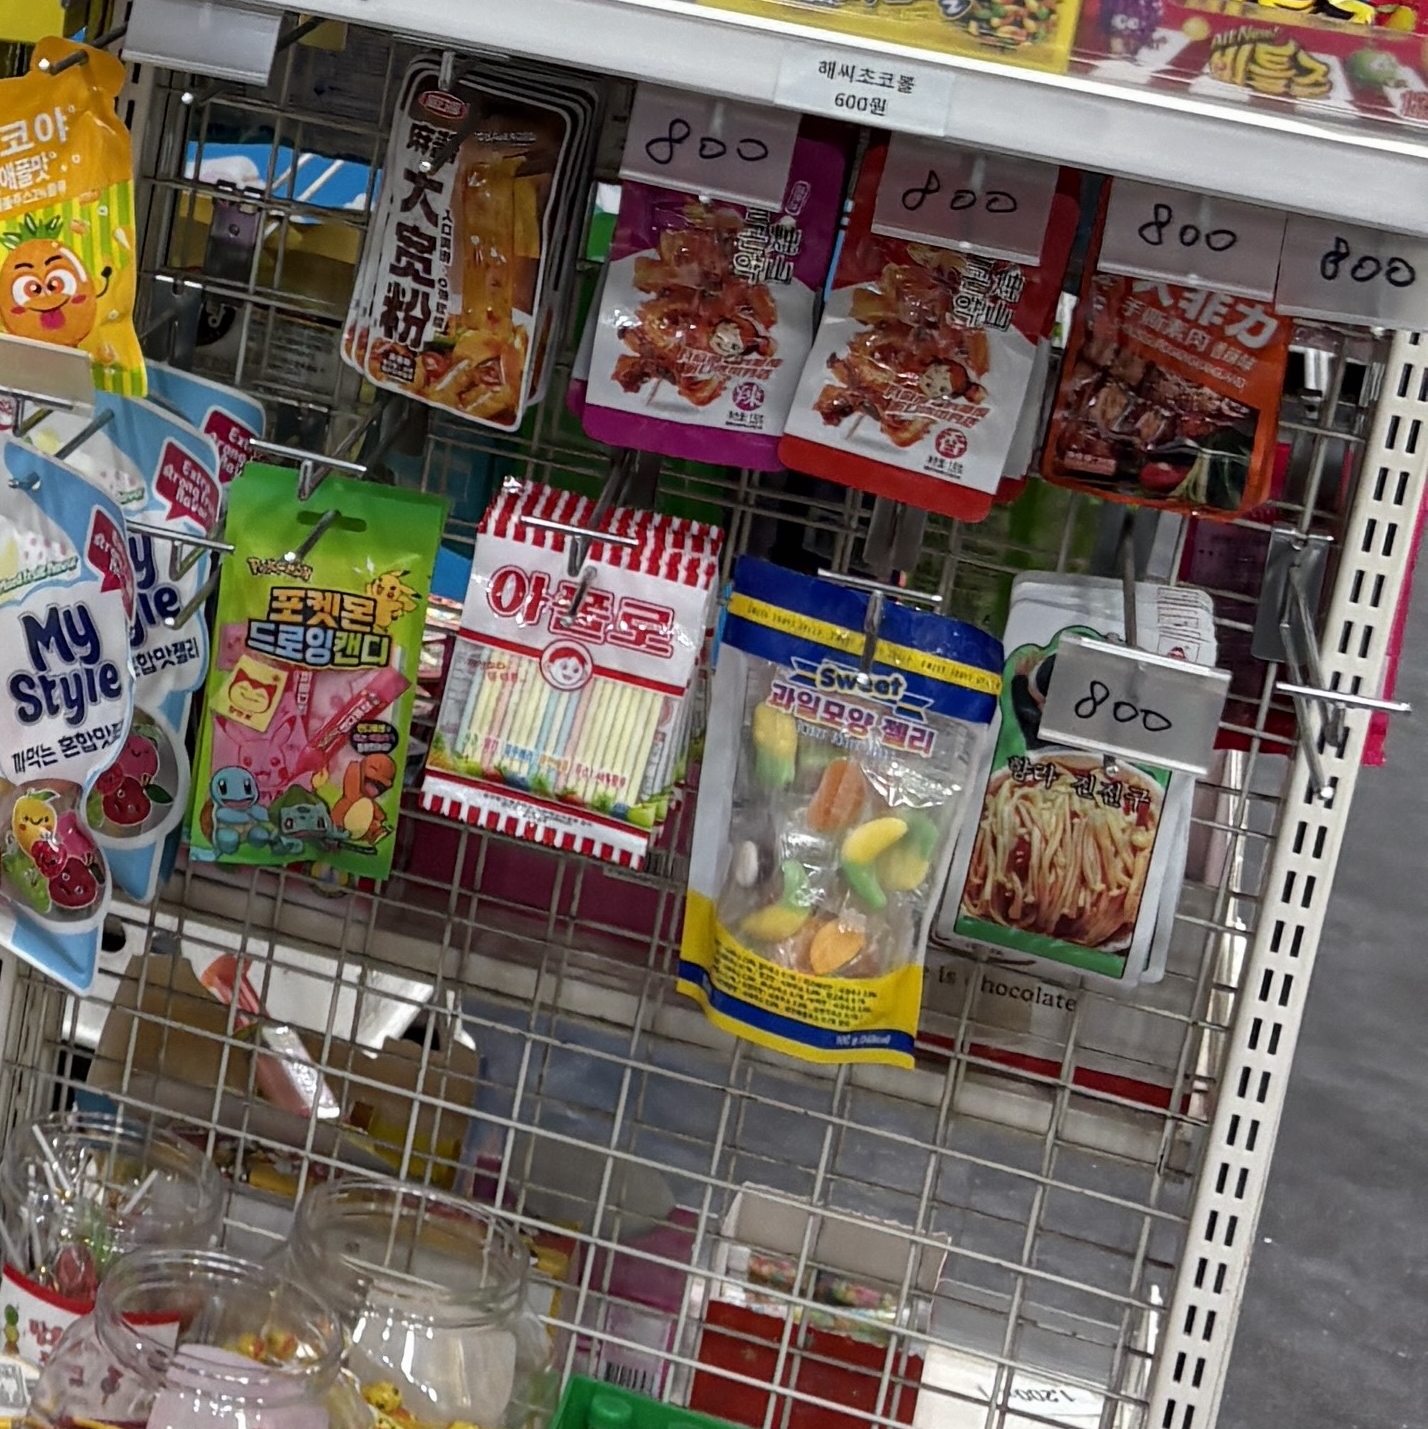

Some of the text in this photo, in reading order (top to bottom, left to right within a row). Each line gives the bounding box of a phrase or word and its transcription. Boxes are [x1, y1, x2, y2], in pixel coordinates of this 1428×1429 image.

[817, 57, 917, 96] 해씨초코볼
[832, 91, 890, 117] 600원
[645, 118, 770, 165] 800
[900, 169, 1020, 215] 800
[1137, 202, 1239, 253] 800
[1318, 235, 1418, 288] 800
[266, 586, 378, 634] 포켓몬
[486, 563, 676, 660] 아폴로
[21, 602, 102, 673] My
[245, 617, 393, 669] 드로잉캔디
[8, 658, 124, 726] Style
[1073, 678, 1174, 733] 800
[767, 682, 938, 760] 과일모양 젤리
[11, 744, 60, 775] 까먹는
[980, 972, 1079, 1013] hocolate
